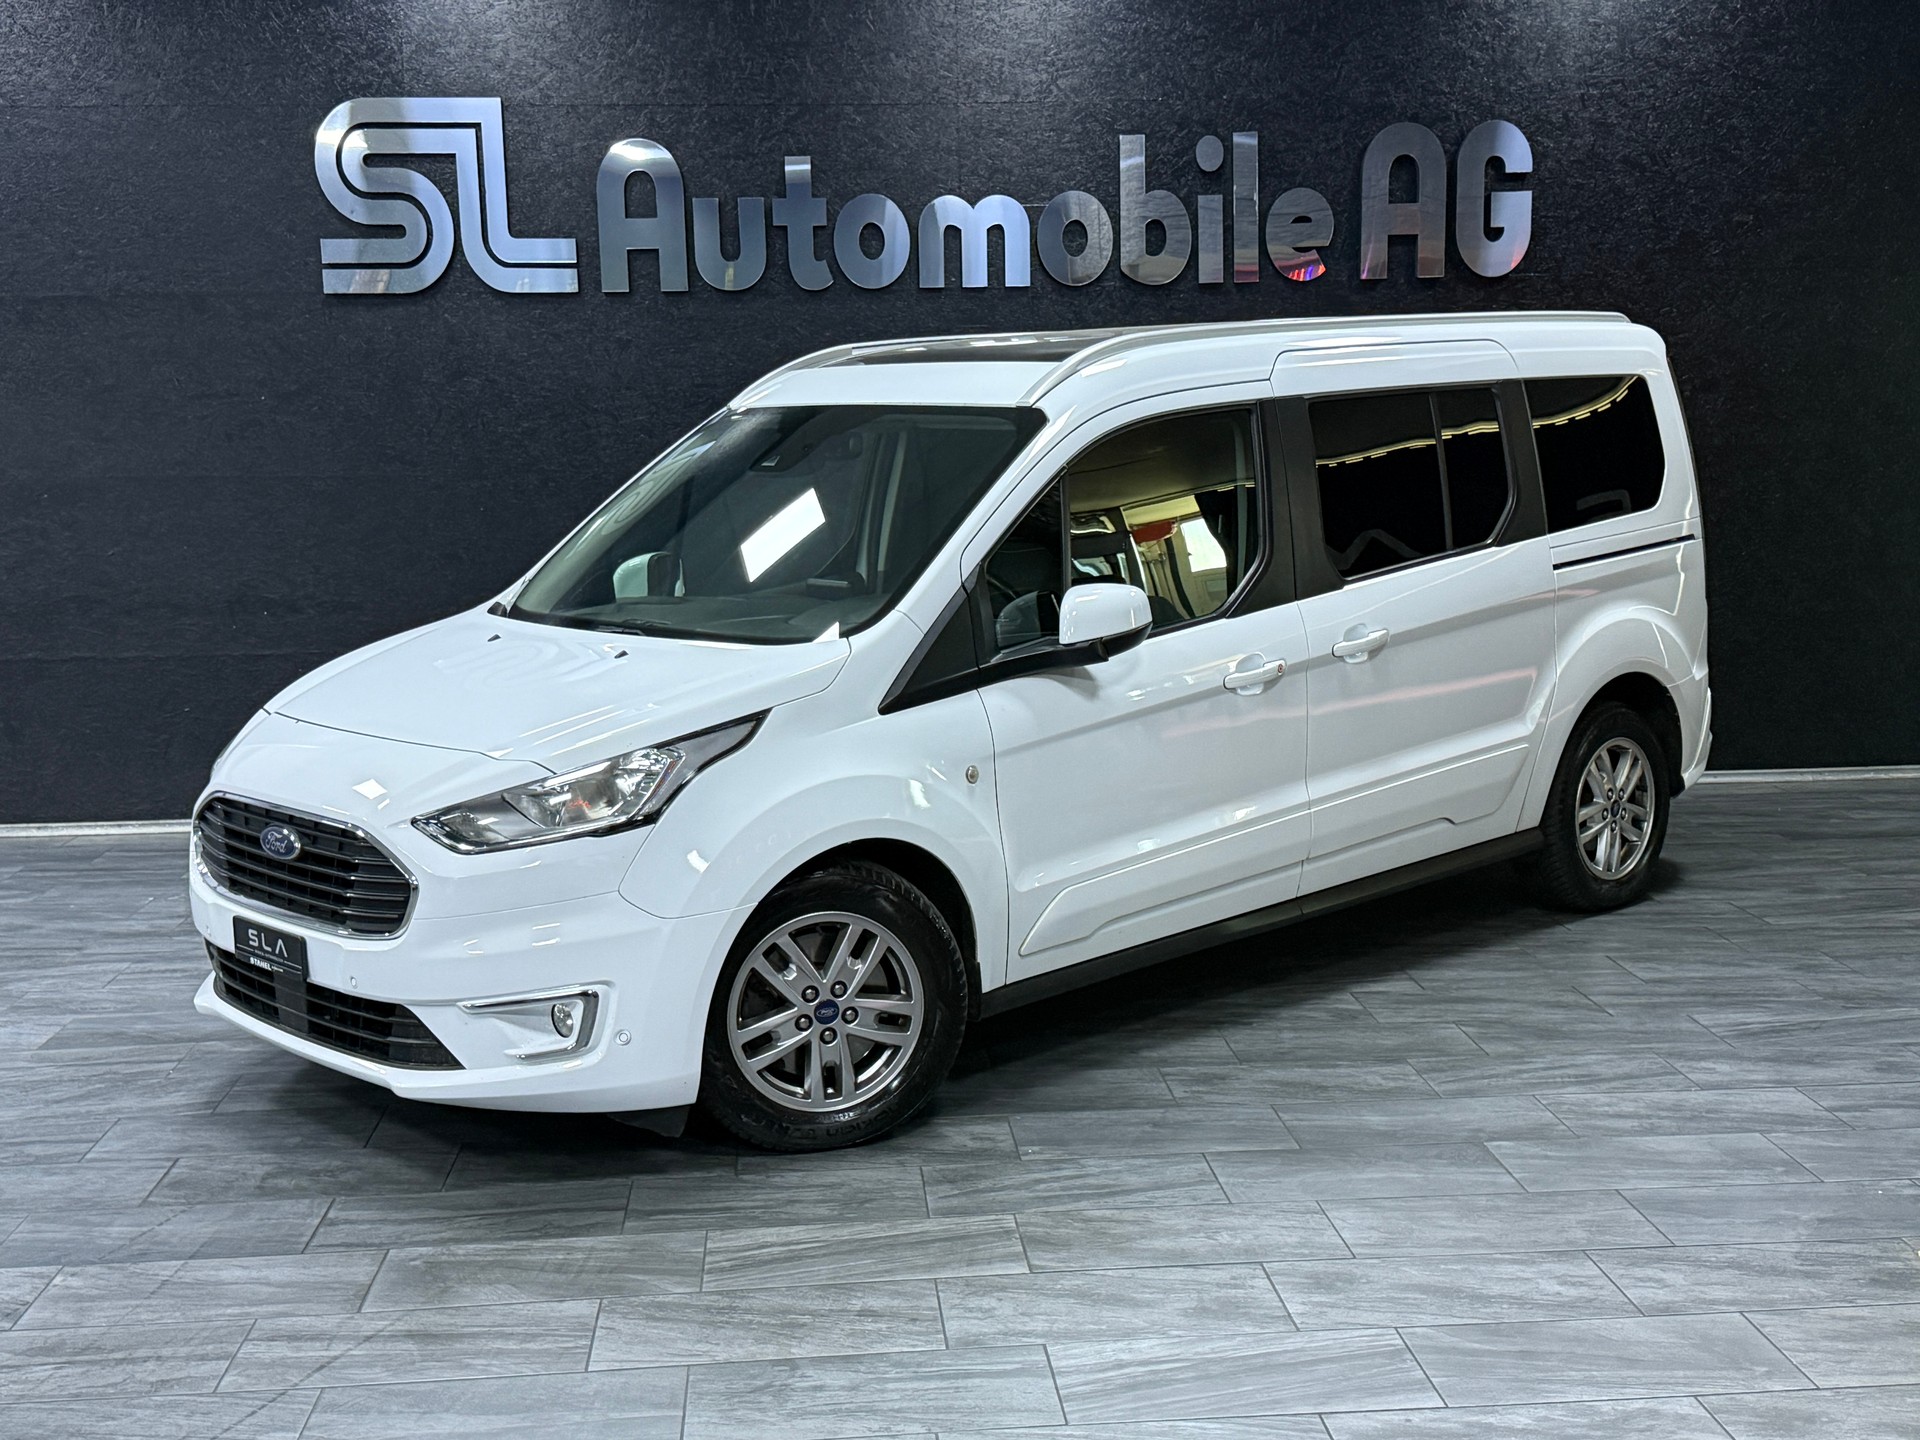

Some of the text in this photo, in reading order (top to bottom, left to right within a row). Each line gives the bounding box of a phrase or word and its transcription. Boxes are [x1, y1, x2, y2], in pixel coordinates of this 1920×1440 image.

[314, 97, 1534, 294] SL Automobile AG
[265, 831, 288, 853] Ford
[248, 928, 288, 958] SLA
